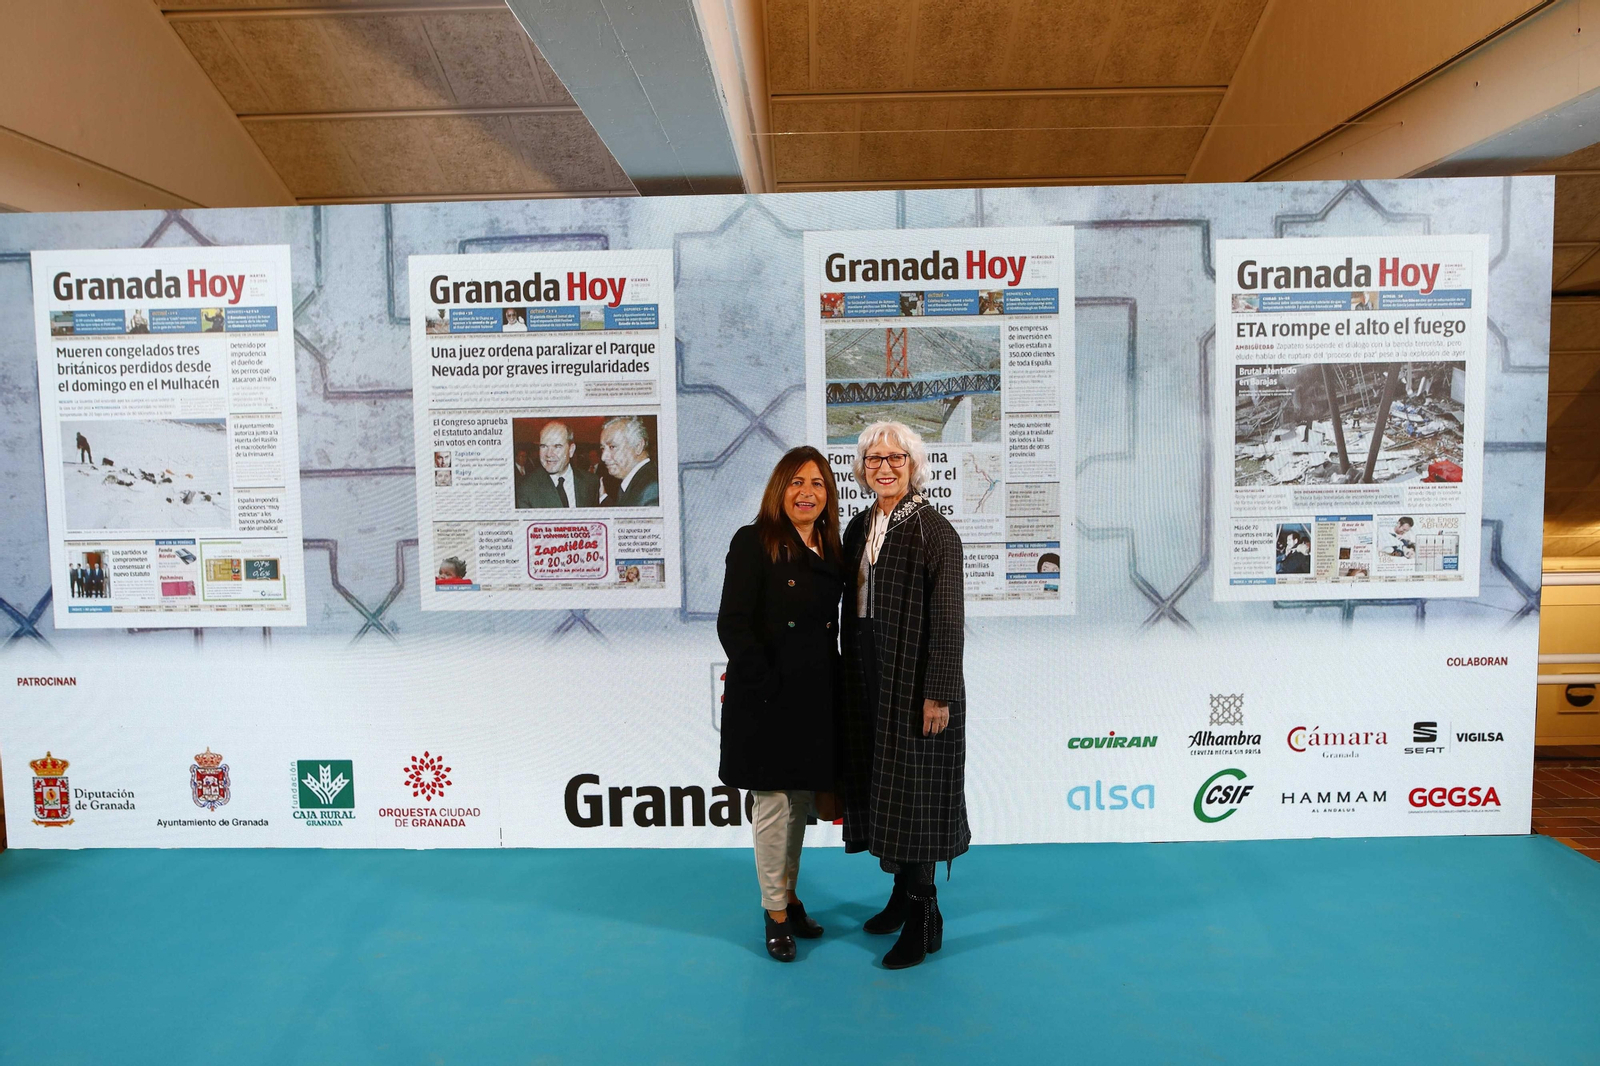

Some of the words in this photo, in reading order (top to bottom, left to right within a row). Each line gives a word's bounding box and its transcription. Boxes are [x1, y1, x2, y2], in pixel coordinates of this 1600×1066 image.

[825, 250, 959, 282] Granada
[966, 250, 1026, 286] Hoy
[1237, 258, 1371, 290] Granada
[1379, 258, 1440, 294] Hoy
[53, 270, 181, 301] Granada
[187, 269, 245, 304] Hoy
[430, 272, 560, 304] Granada
[567, 272, 626, 308] Hoy
[1236, 322, 1267, 338] ETA
[1272, 322, 1330, 340] rompe
[1335, 319, 1351, 335] el
[1355, 318, 1389, 335] alto
[1394, 318, 1409, 334] el
[1414, 317, 1466, 337] fuego
[56, 346, 103, 358] Mueren
[106, 344, 175, 360] congelados
[178, 344, 200, 356] tres
[431, 346, 457, 359] Una
[459, 344, 485, 361] juez
[488, 344, 533, 357] ordena
[536, 342, 593, 360] paralizar
[595, 342, 607, 354] el
[610, 342, 656, 357] Parque
[58, 362, 117, 376] británicos
[121, 361, 172, 376] perdidos
[176, 361, 211, 373] desde
[432, 364, 480, 377] Nevada
[483, 366, 504, 379] por
[507, 363, 548, 378] graves
[551, 360, 649, 376] irregularidades
[1239, 367, 1262, 375] Brutal
[58, 380, 69, 392] el
[72, 379, 126, 394] domingo
[129, 380, 144, 391] en
[147, 379, 158, 390] el
[161, 378, 220, 390] Mulhacén
[945, 467, 956, 480] el
[534, 540, 598, 556] Zapatillas
[1447, 657, 1508, 667] COLABORAN
[17, 677, 76, 686] PATROCINAN
[1188, 731, 1261, 749] Alhambra
[1287, 726, 1388, 752] Cámara
[1456, 732, 1504, 742] VIGILSA
[74, 788, 135, 800] Diputación
[564, 773, 752, 828] Grana
[1067, 780, 1154, 811] alsa
[1205, 785, 1254, 804] CSIF
[1281, 791, 1387, 804] HAMMAM
[75, 800, 88, 810] de
[91, 800, 135, 810] Granada
[379, 808, 437, 818] ORQUESTA
[439, 807, 481, 817] CIUDAD
[157, 818, 216, 827] Ayuntamiento
[232, 818, 269, 826] Granada
[293, 811, 318, 820] CAJA
[320, 810, 356, 819] RURAL
[395, 819, 409, 828] DE
[412, 818, 466, 827] GRANADA
